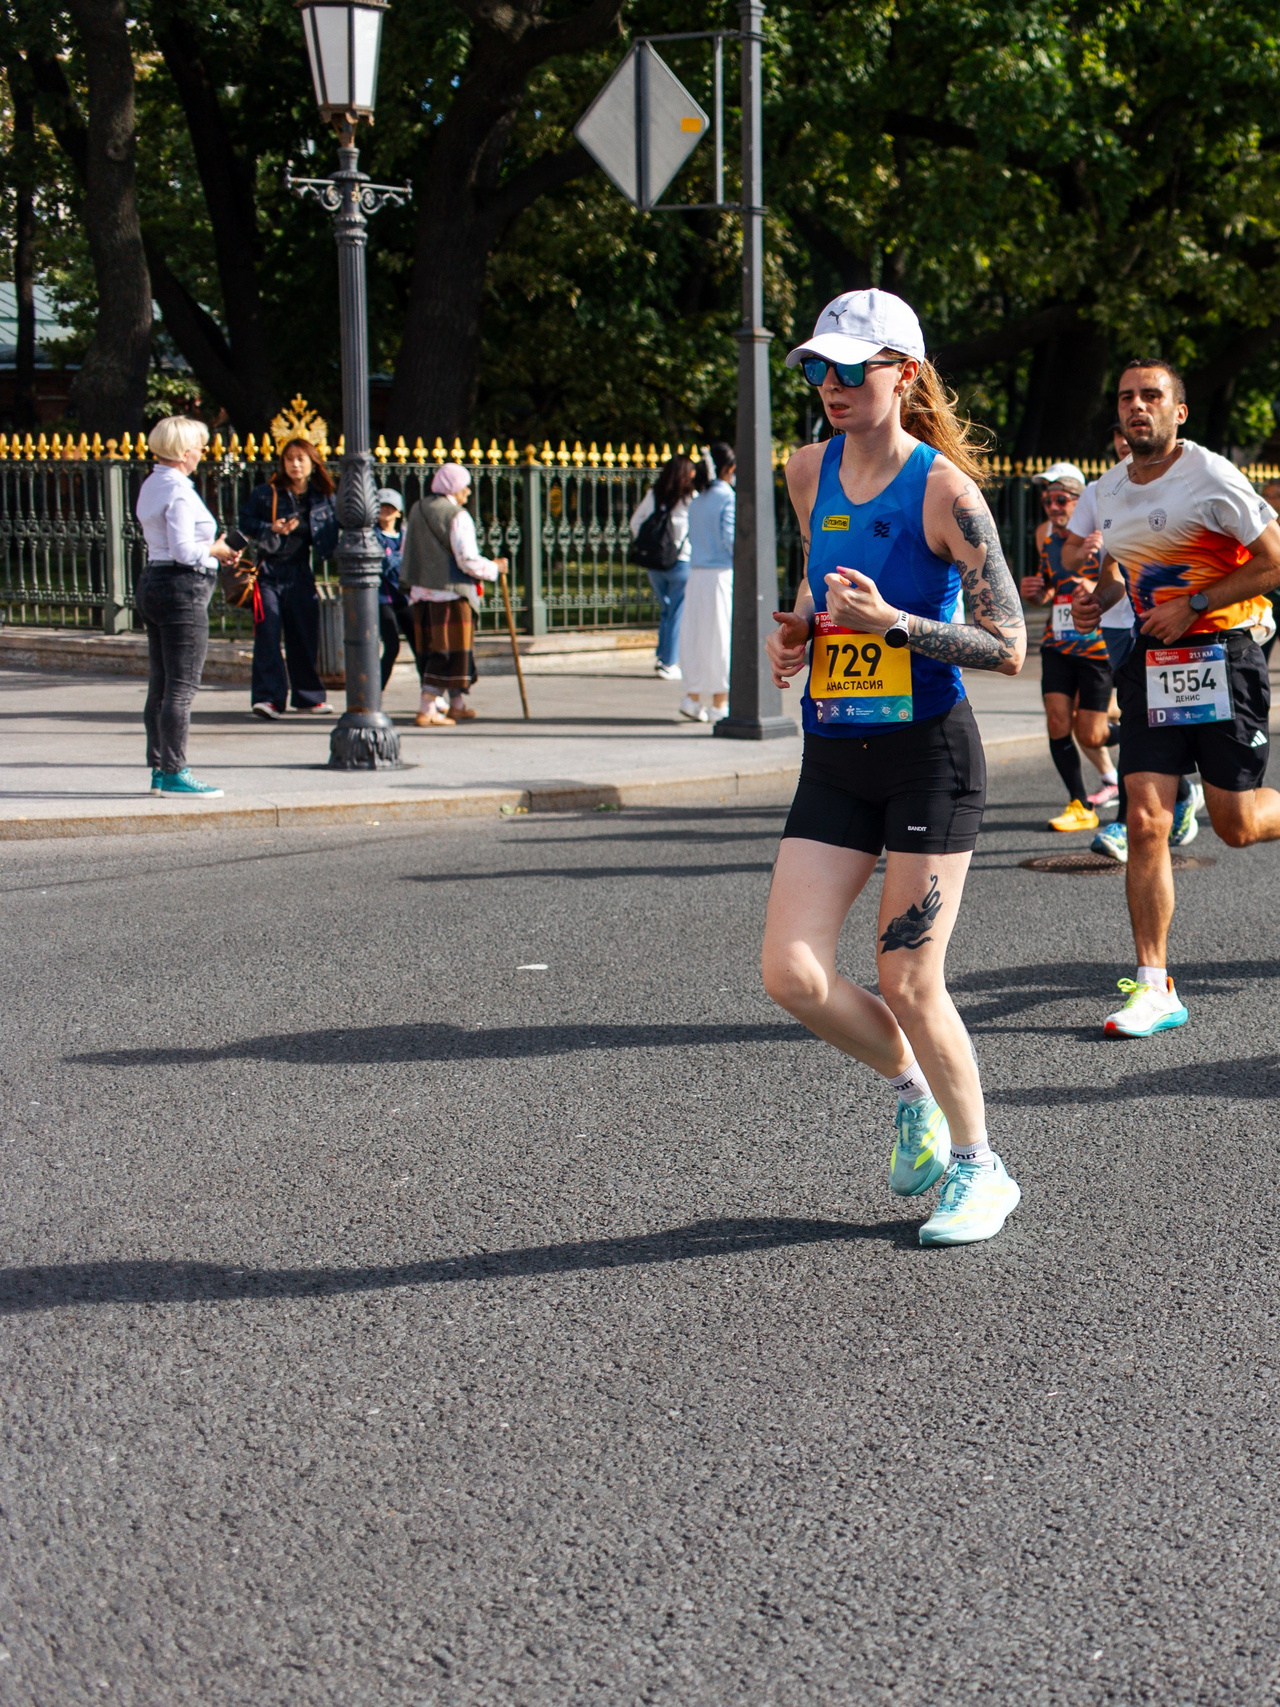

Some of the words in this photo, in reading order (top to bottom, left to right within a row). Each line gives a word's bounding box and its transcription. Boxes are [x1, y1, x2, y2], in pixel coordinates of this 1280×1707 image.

[826, 642, 882, 678] 729
[826, 680, 884, 692] АНАСТАСИЯ
[1159, 668, 1217, 694] 1554
[1175, 694, 1201, 703] ДЕНИС
[1156, 709, 1167, 723] D
